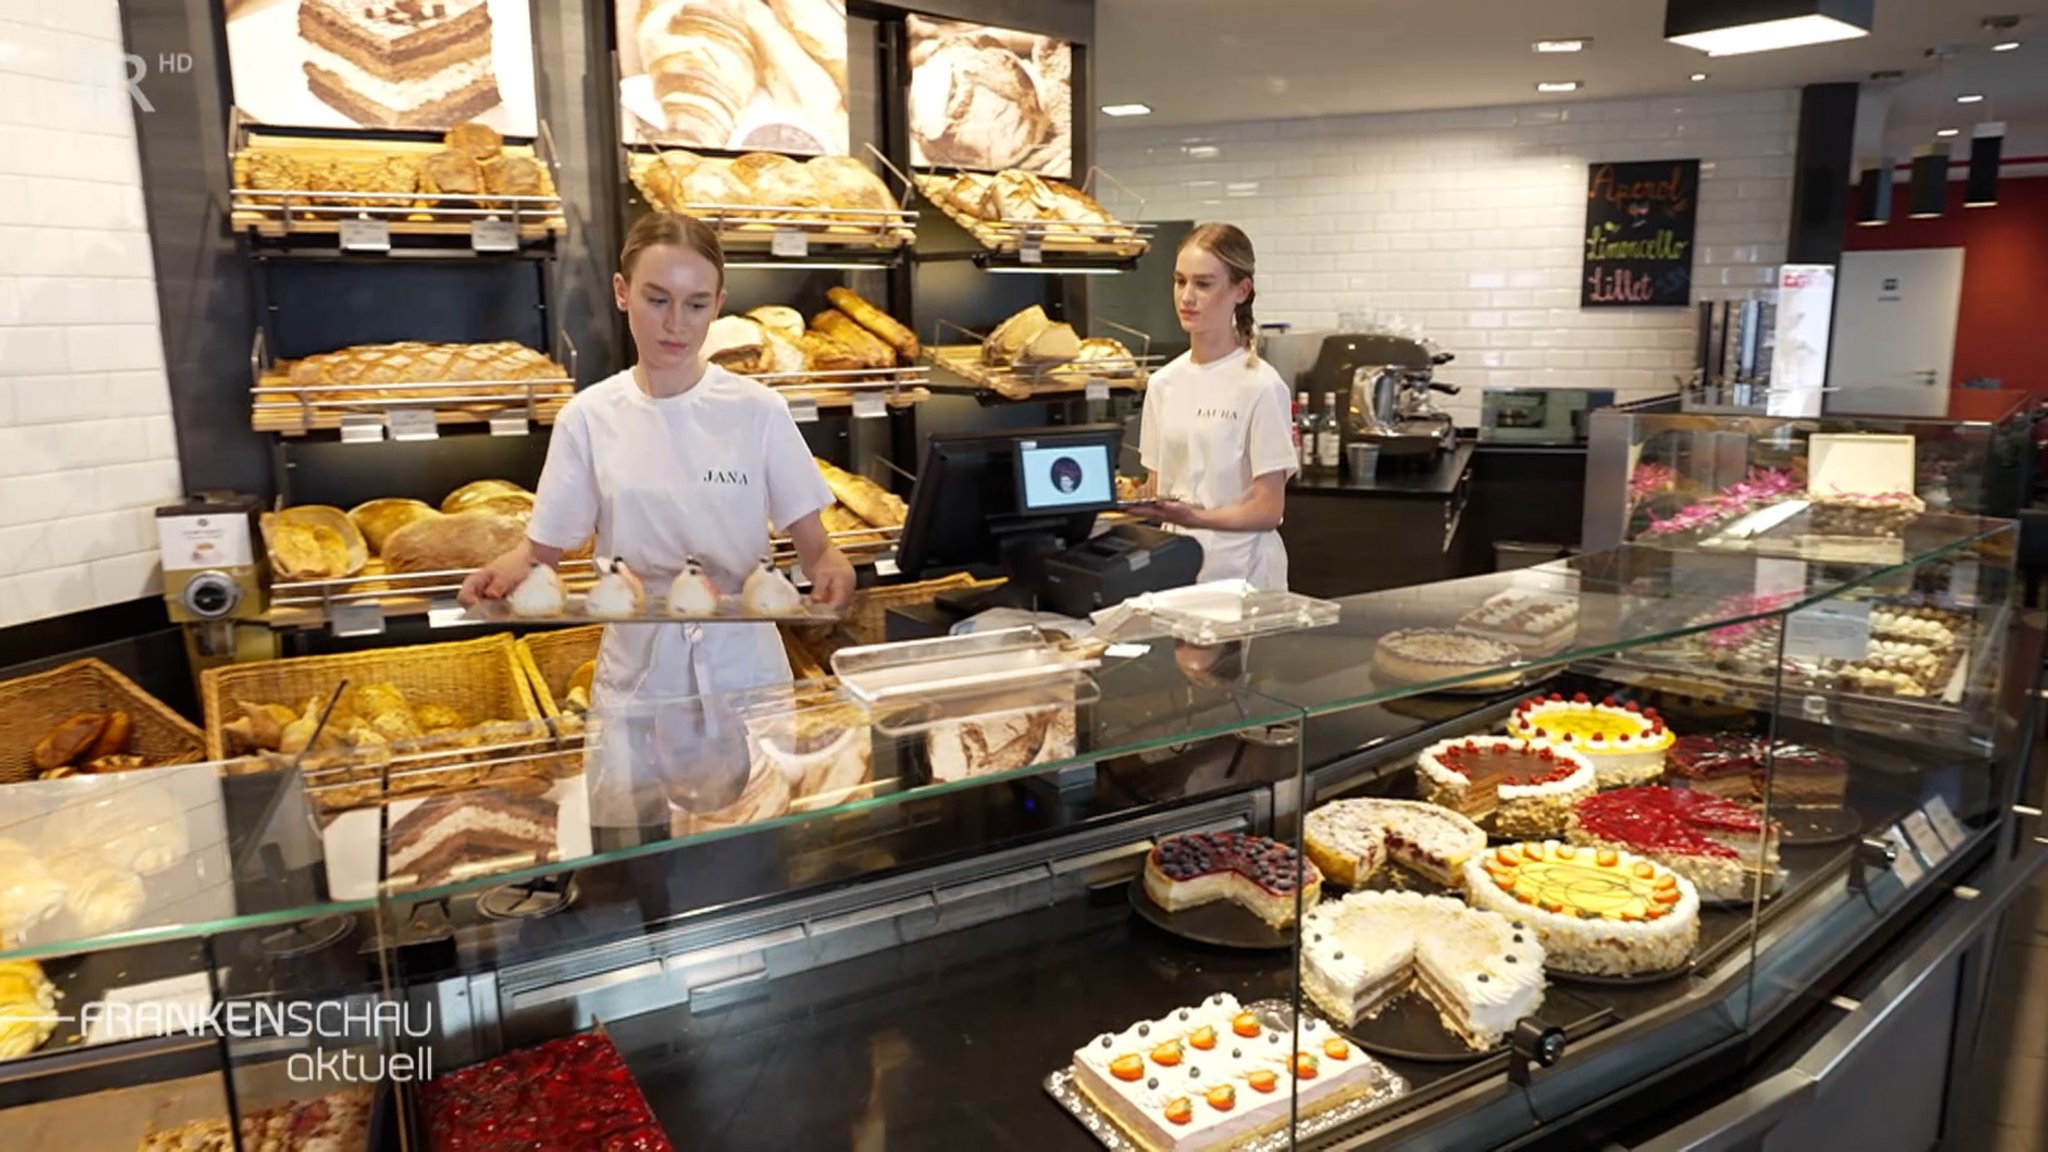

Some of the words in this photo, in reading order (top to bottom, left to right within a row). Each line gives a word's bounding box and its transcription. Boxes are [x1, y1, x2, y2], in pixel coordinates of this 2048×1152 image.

[1587, 164, 1683, 209] Aperol
[1586, 225, 1688, 261] Limoncello
[1588, 266, 1653, 302] Lillet
[1197, 408, 1238, 420] LAURA
[703, 470, 748, 485] JANA
